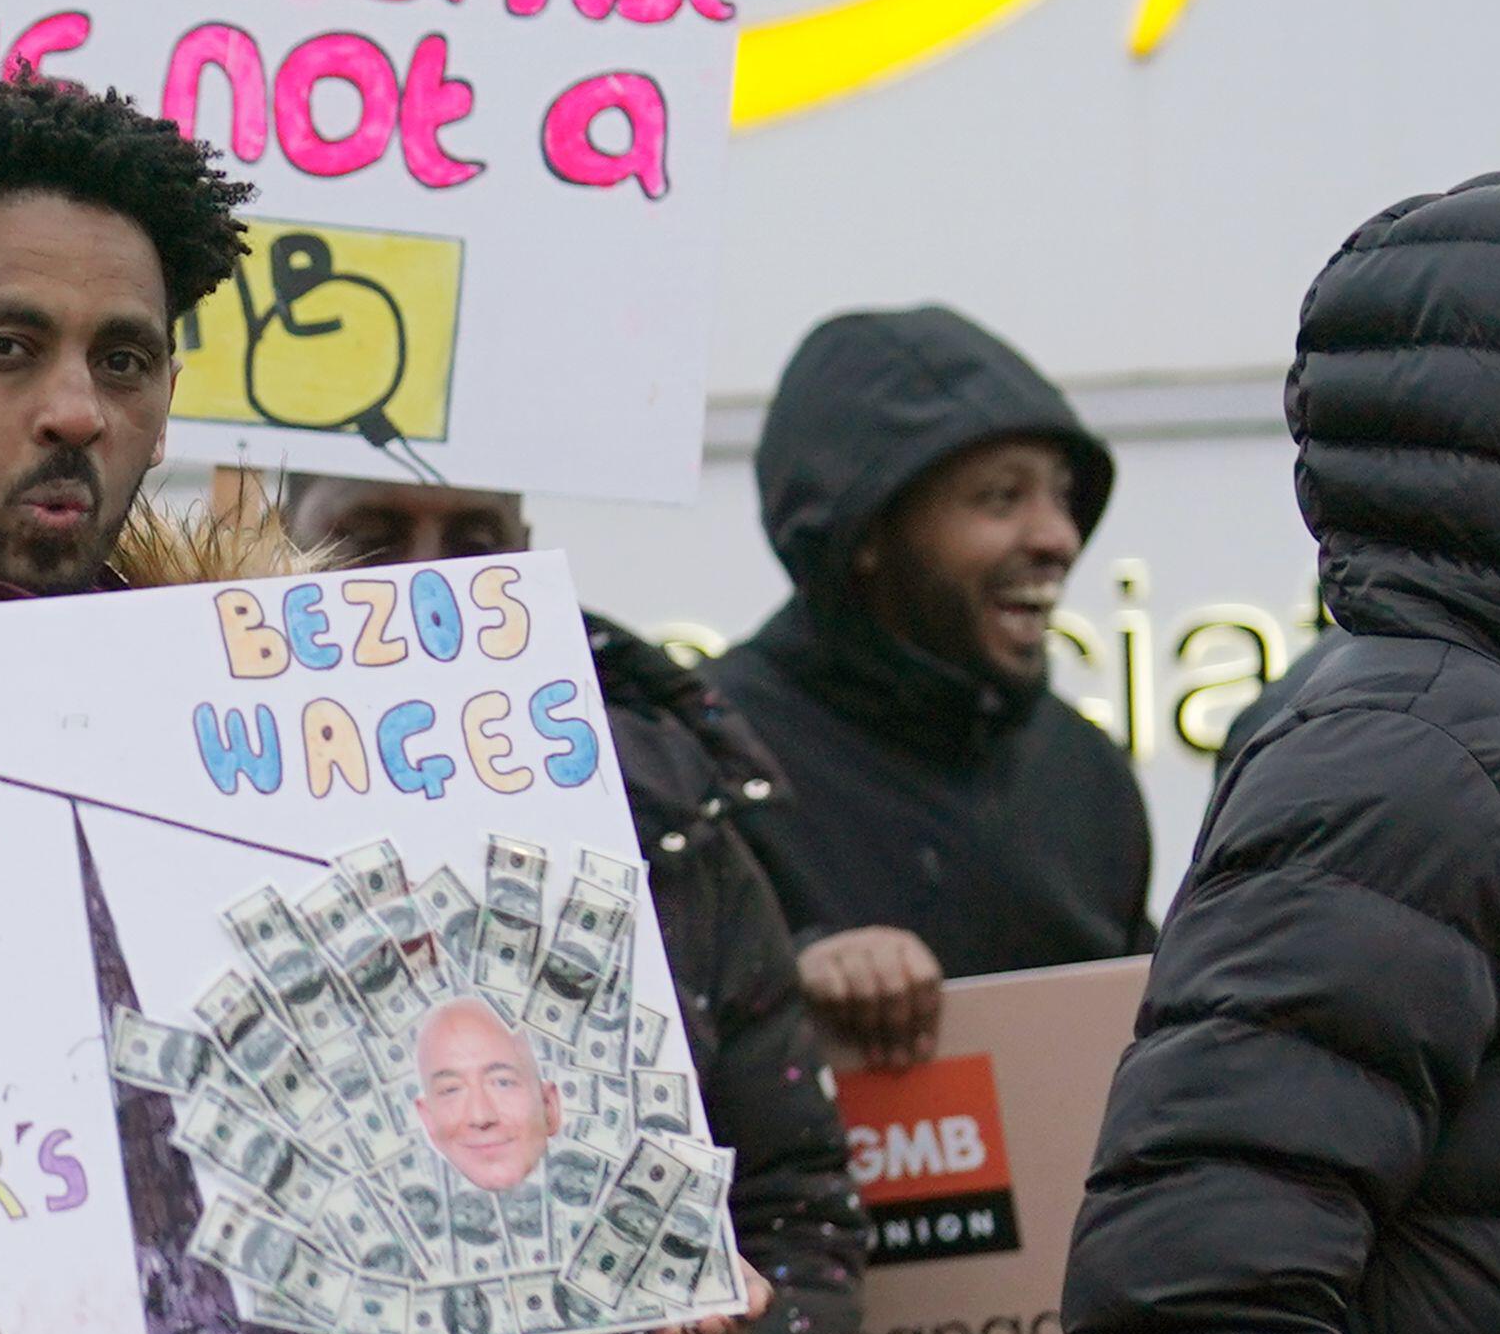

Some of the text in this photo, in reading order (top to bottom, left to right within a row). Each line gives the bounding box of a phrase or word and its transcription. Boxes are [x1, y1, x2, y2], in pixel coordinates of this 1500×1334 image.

[541, 70, 669, 199] a
[213, 565, 531, 679] BEZOS
[193, 679, 600, 801] WAGES
[846, 1115, 986, 1182] GMB
